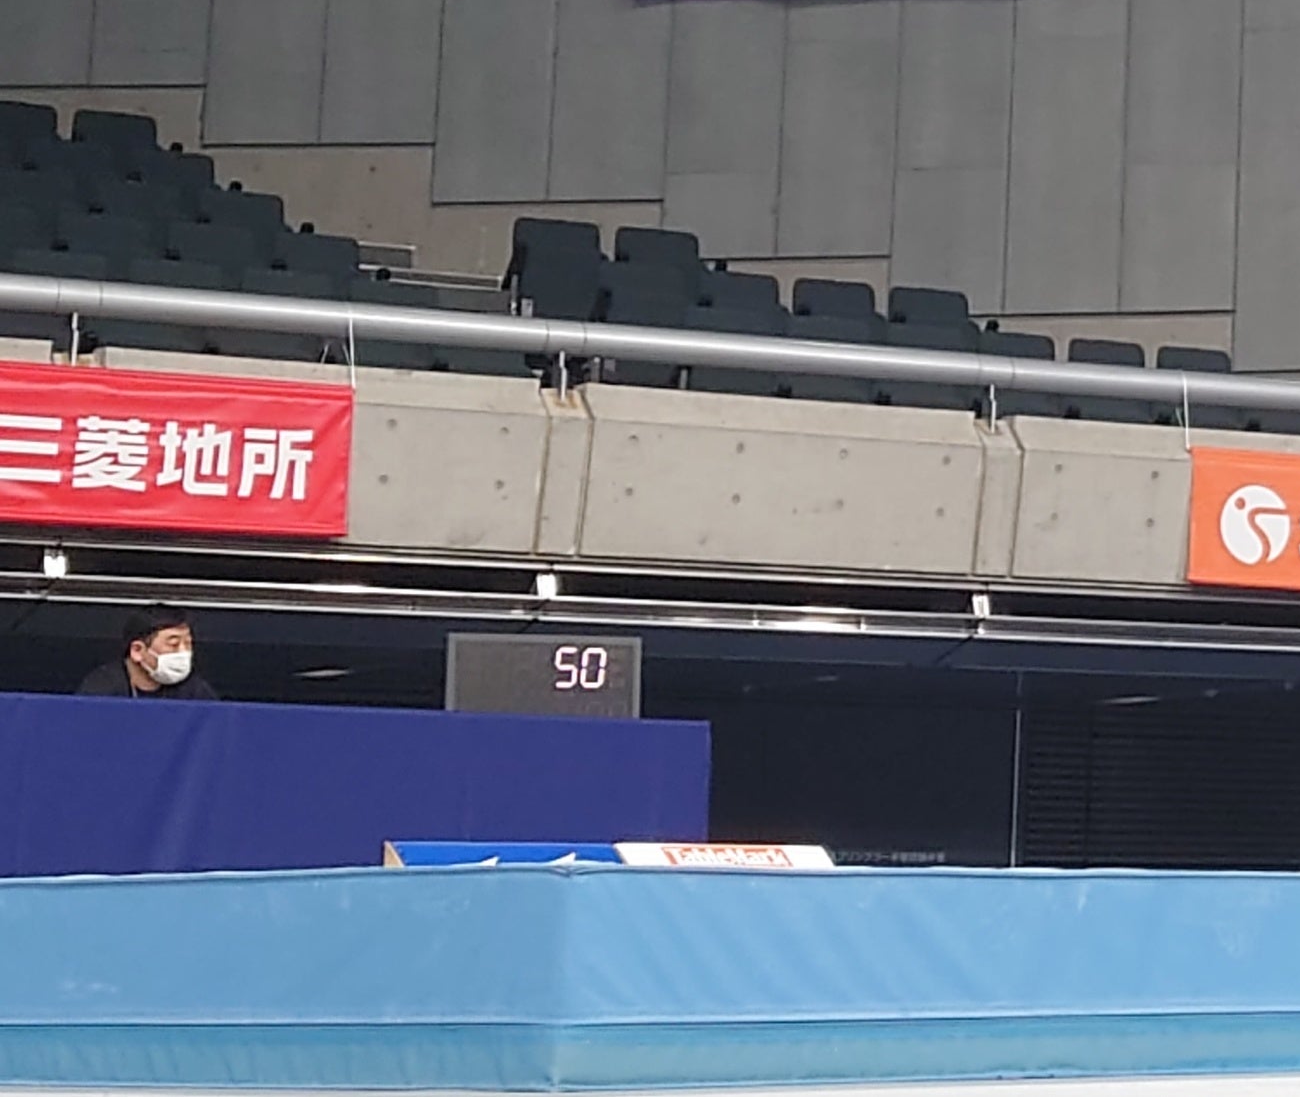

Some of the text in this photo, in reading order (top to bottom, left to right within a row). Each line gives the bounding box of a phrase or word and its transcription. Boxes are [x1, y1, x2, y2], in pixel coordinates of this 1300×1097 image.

[0, 413, 314, 501] 三菱地所
[555, 646, 607, 689] 50
